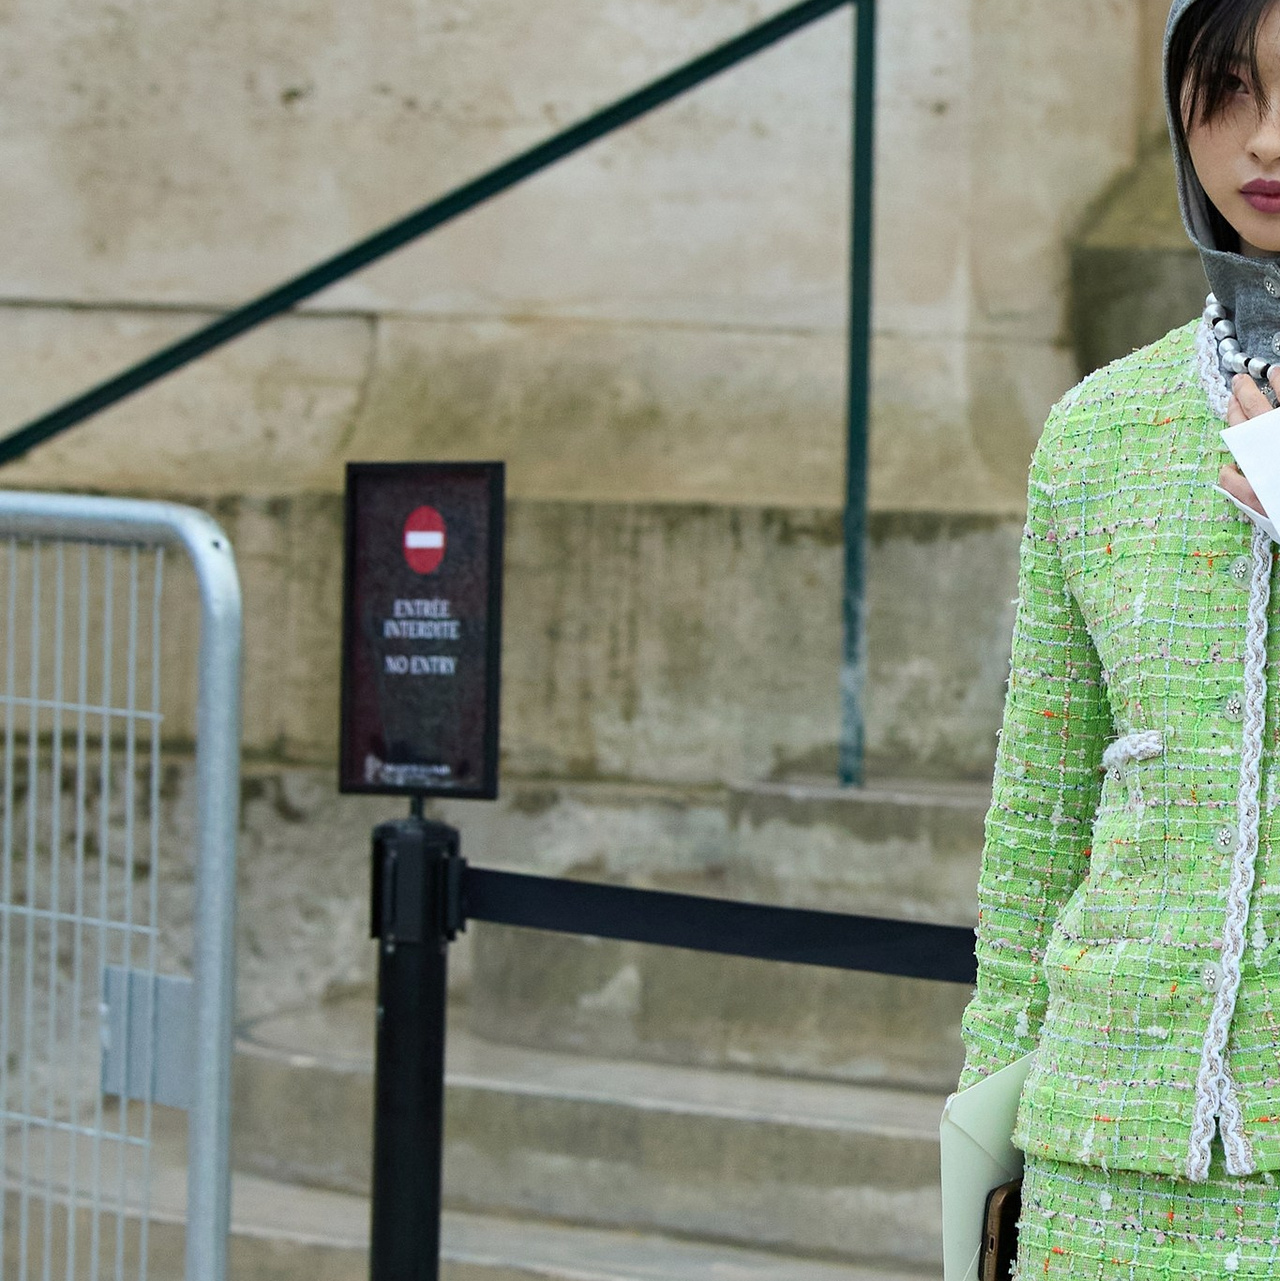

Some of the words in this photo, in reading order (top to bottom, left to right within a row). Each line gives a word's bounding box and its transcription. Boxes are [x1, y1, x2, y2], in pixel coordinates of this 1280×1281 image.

[383, 619, 460, 640] INTERDITE
[385, 653, 409, 675] NO
[410, 654, 458, 675] ENTRY
